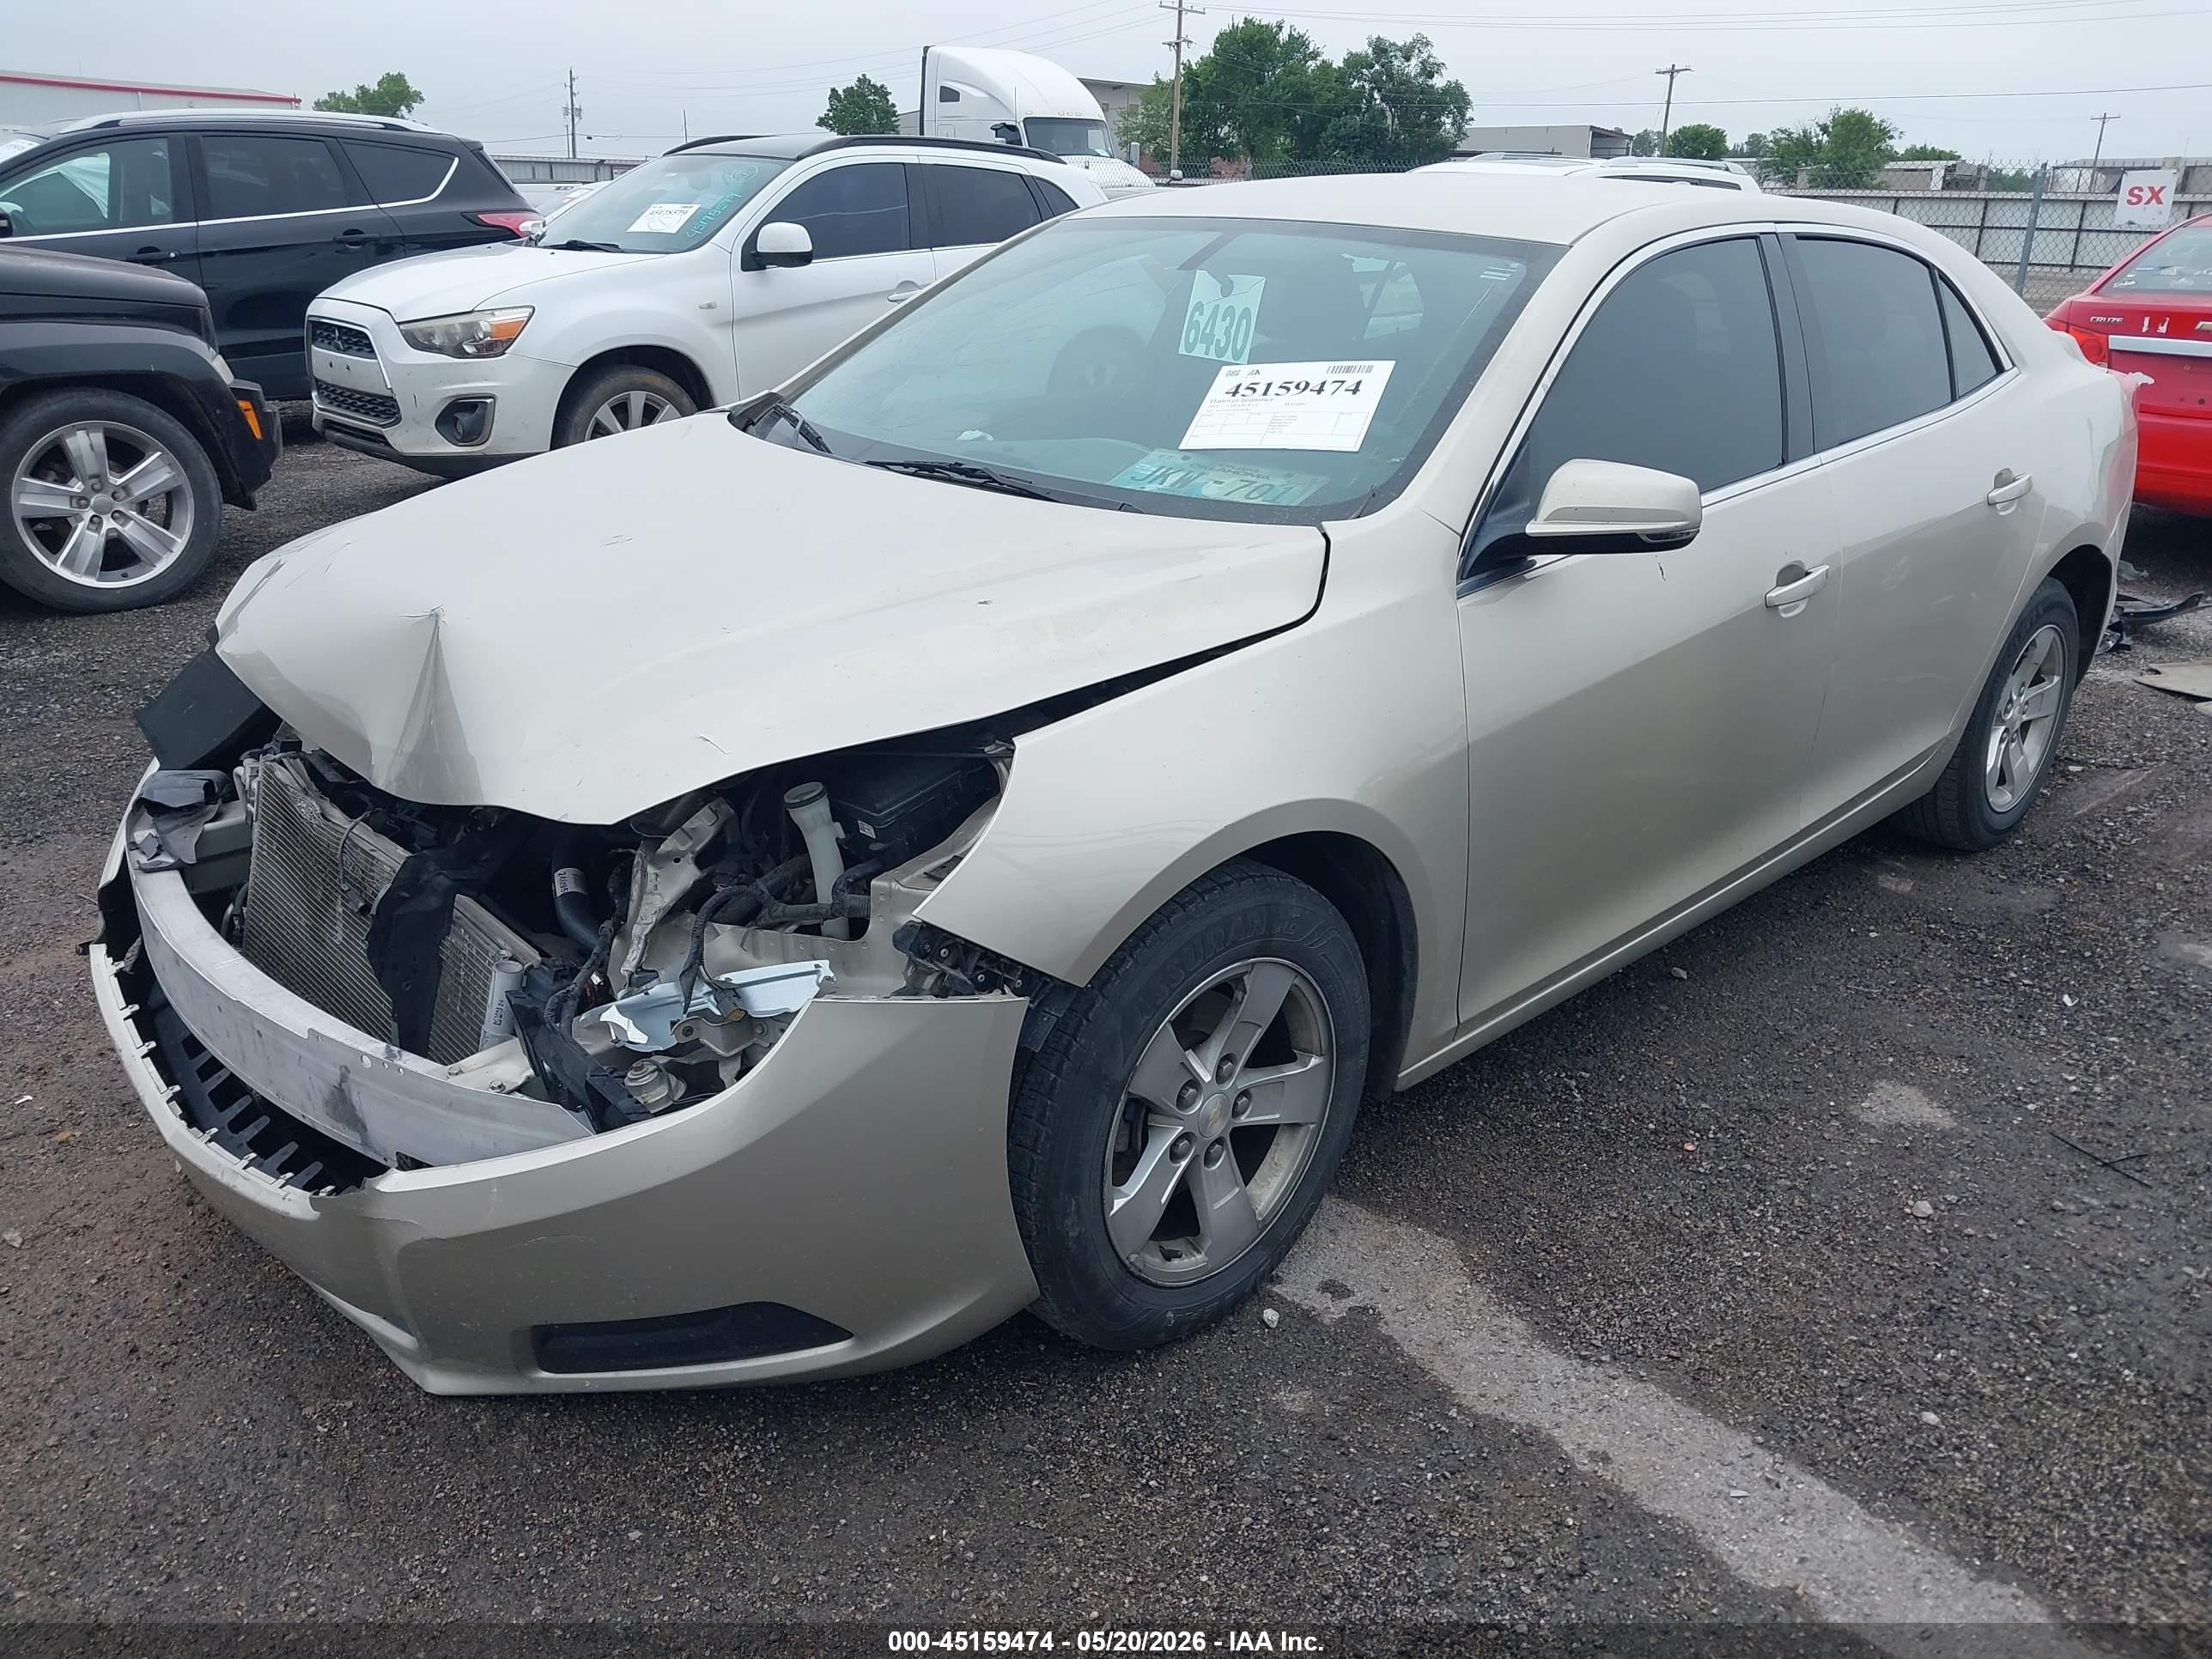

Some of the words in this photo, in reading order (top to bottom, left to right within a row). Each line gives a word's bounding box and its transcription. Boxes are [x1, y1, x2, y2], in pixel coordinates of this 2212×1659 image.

[2126, 185, 2166, 206] SX
[1184, 301, 1253, 362] 6430
[1224, 379, 1364, 398] 45159474
